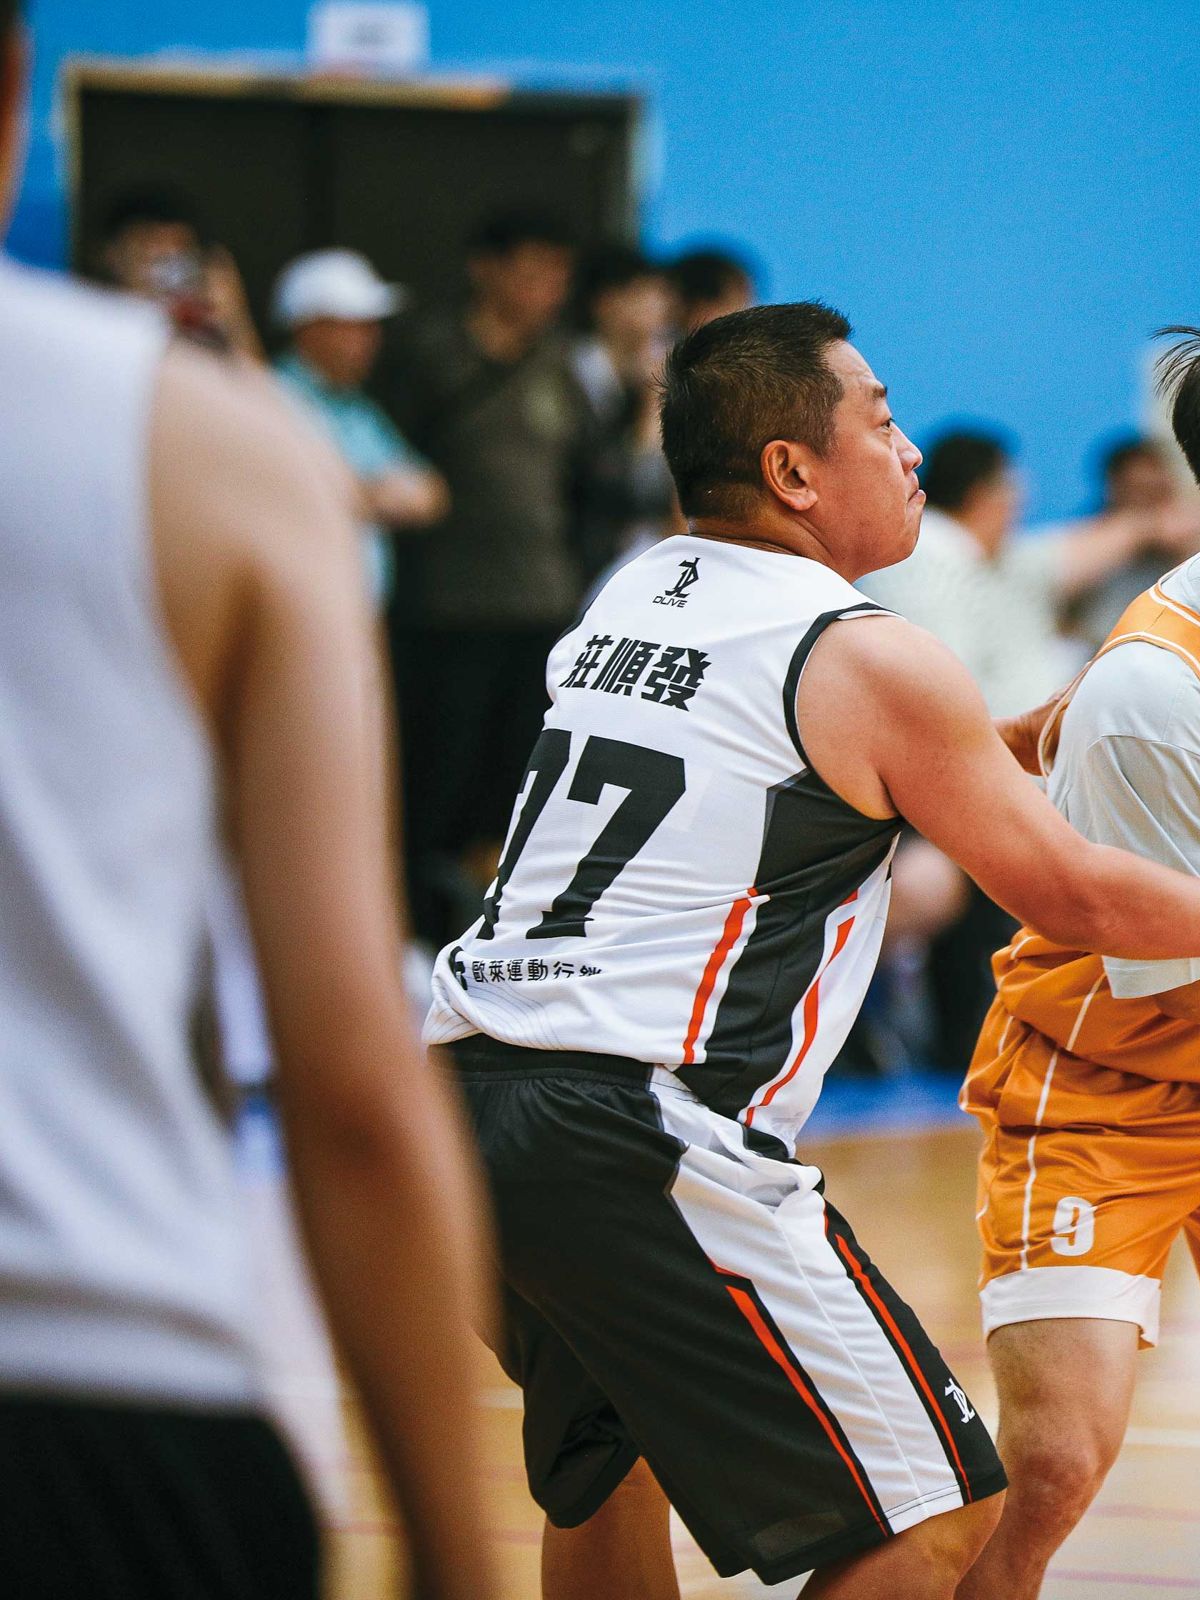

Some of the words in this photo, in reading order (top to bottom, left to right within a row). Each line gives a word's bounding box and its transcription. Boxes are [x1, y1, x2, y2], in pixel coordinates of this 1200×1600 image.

[558, 634, 713, 712] 莊順發
[1050, 1196, 1096, 1256] 9
